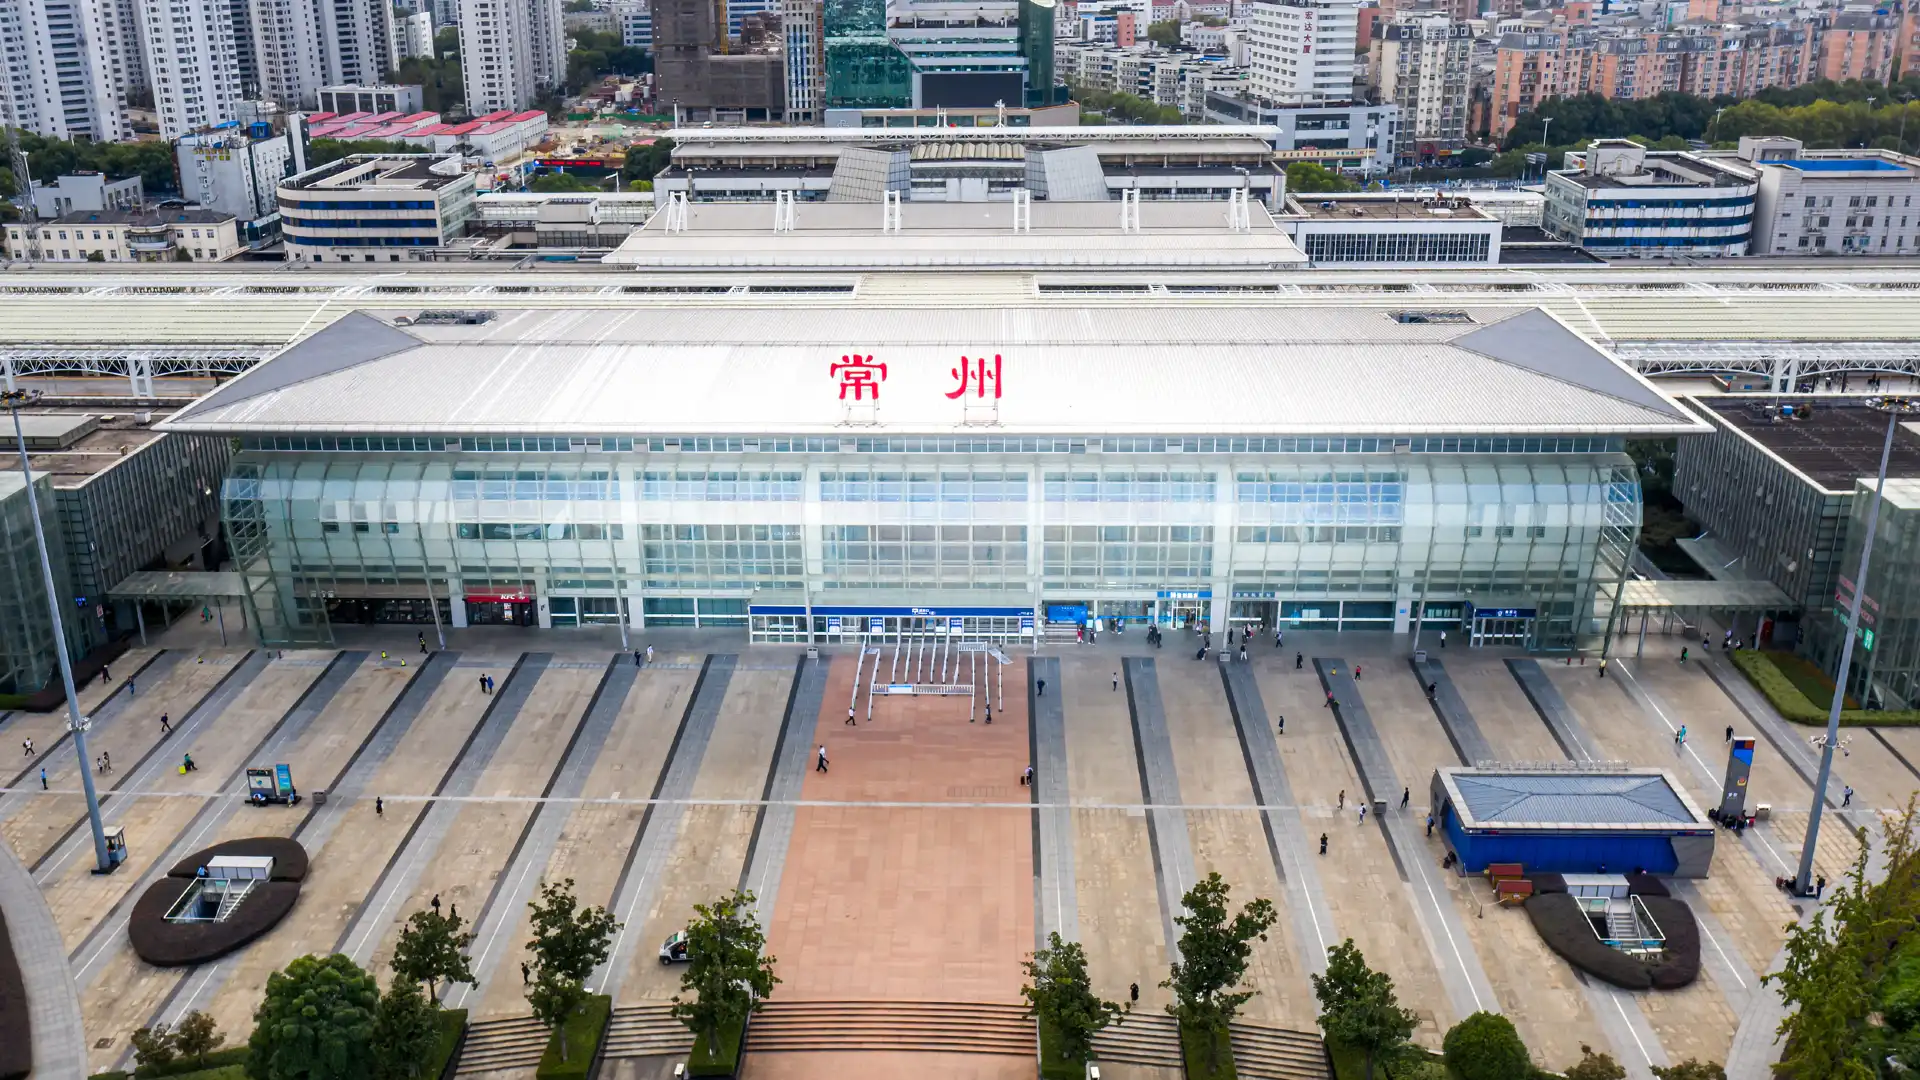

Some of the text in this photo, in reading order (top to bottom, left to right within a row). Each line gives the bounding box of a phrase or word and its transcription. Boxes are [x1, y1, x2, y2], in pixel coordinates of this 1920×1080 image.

[1303, 11, 1314, 53] 宏达大厦
[830, 354, 1002, 400] 常州
